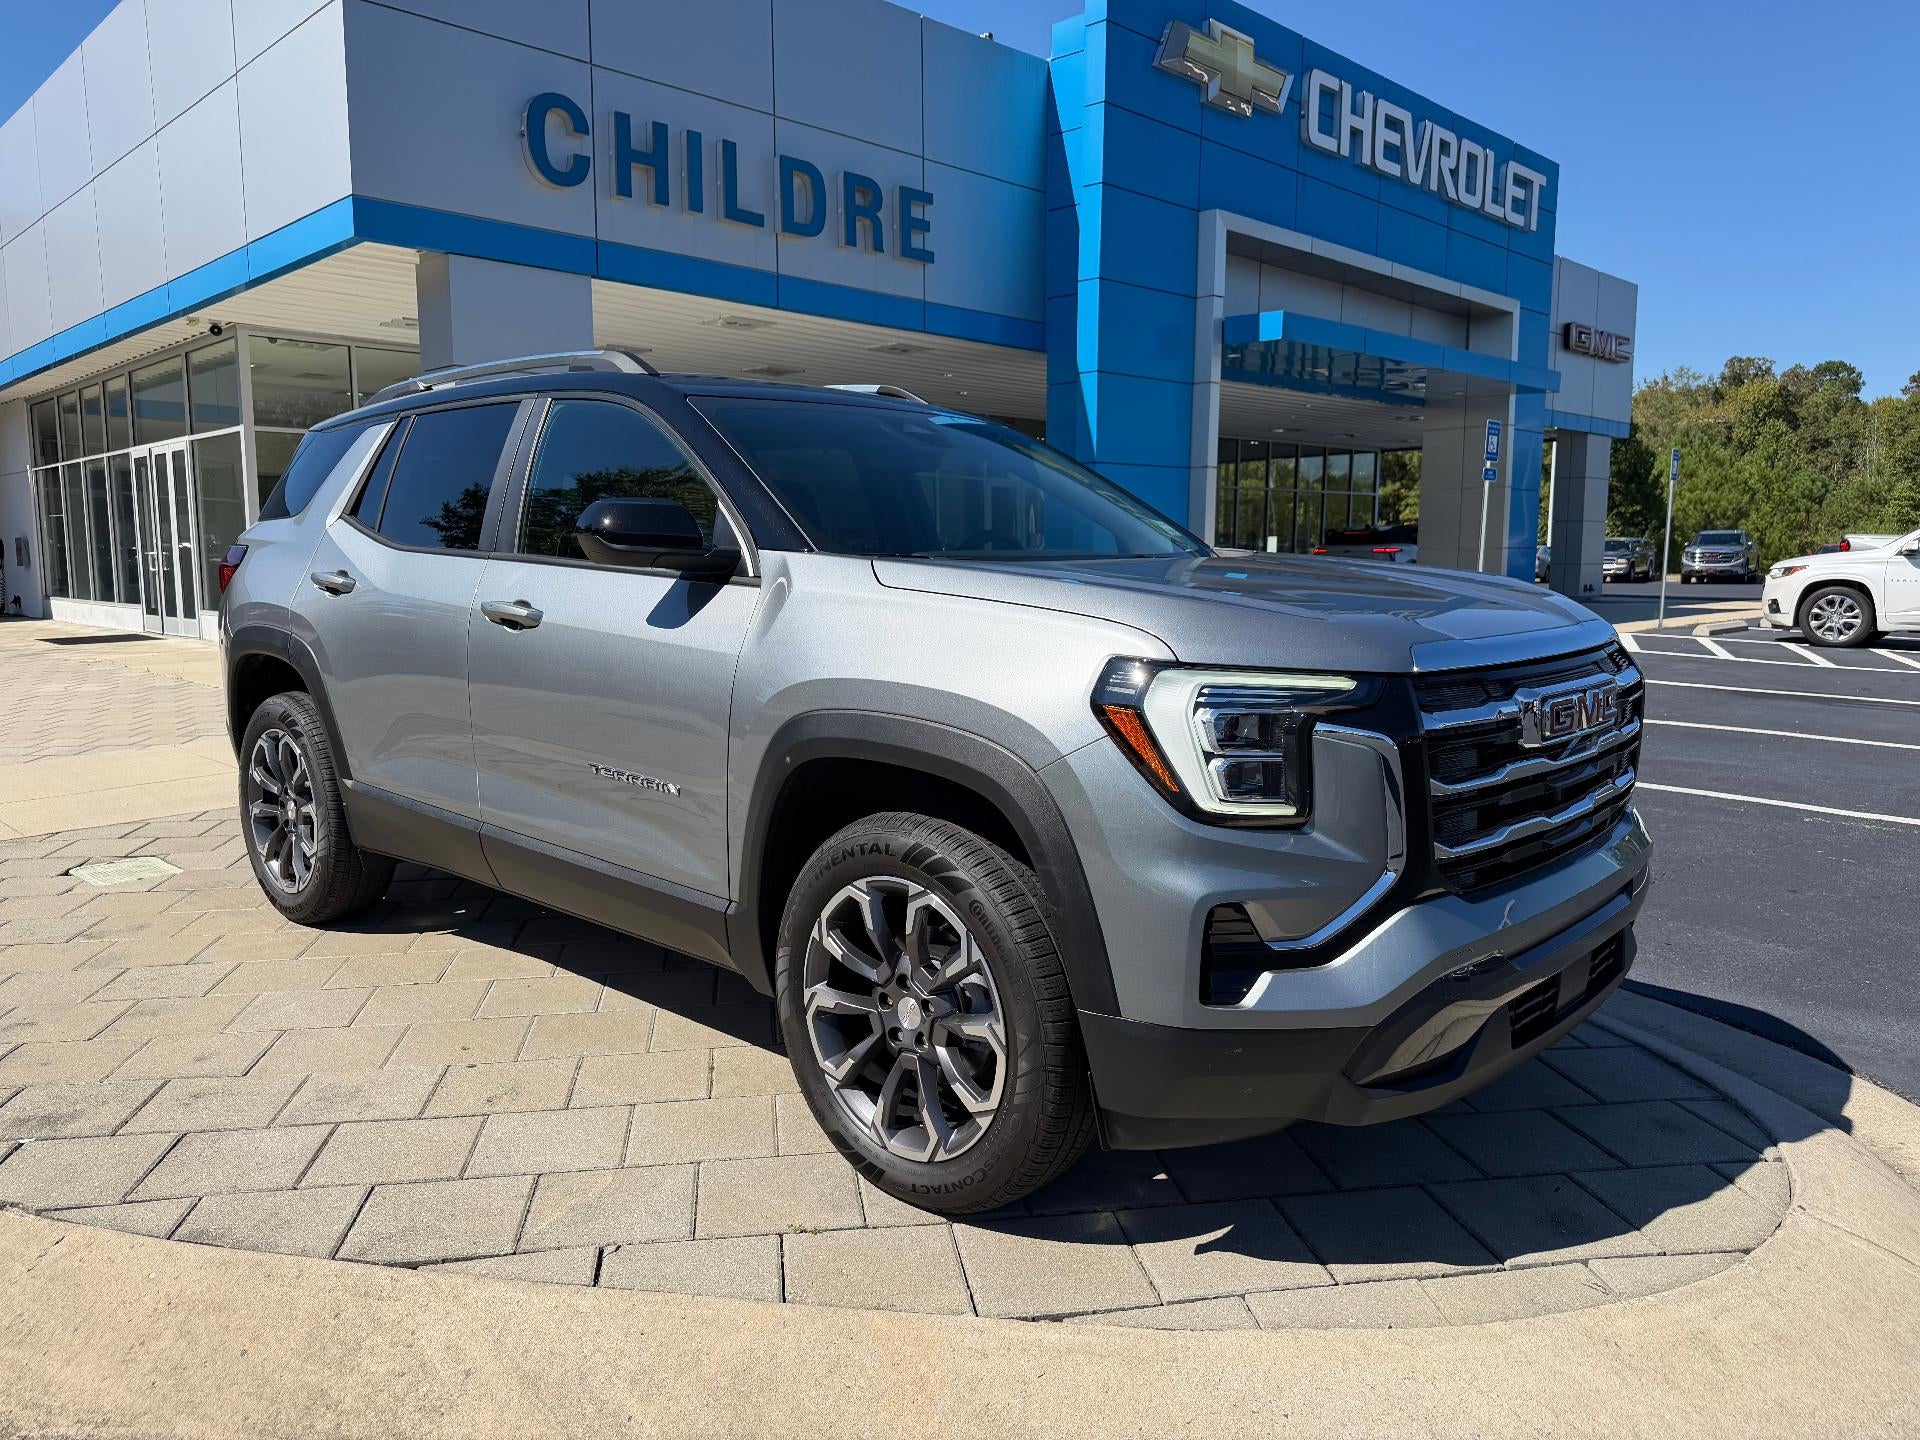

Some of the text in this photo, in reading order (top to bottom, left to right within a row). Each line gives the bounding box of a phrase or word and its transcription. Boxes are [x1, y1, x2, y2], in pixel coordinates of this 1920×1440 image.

[1303, 67, 1547, 232] CHEVROLET
[522, 91, 935, 264] CHILDRE
[1565, 322, 1632, 363] GMC
[1543, 683, 1618, 735] GMC
[587, 761, 681, 798] TERRAIN
